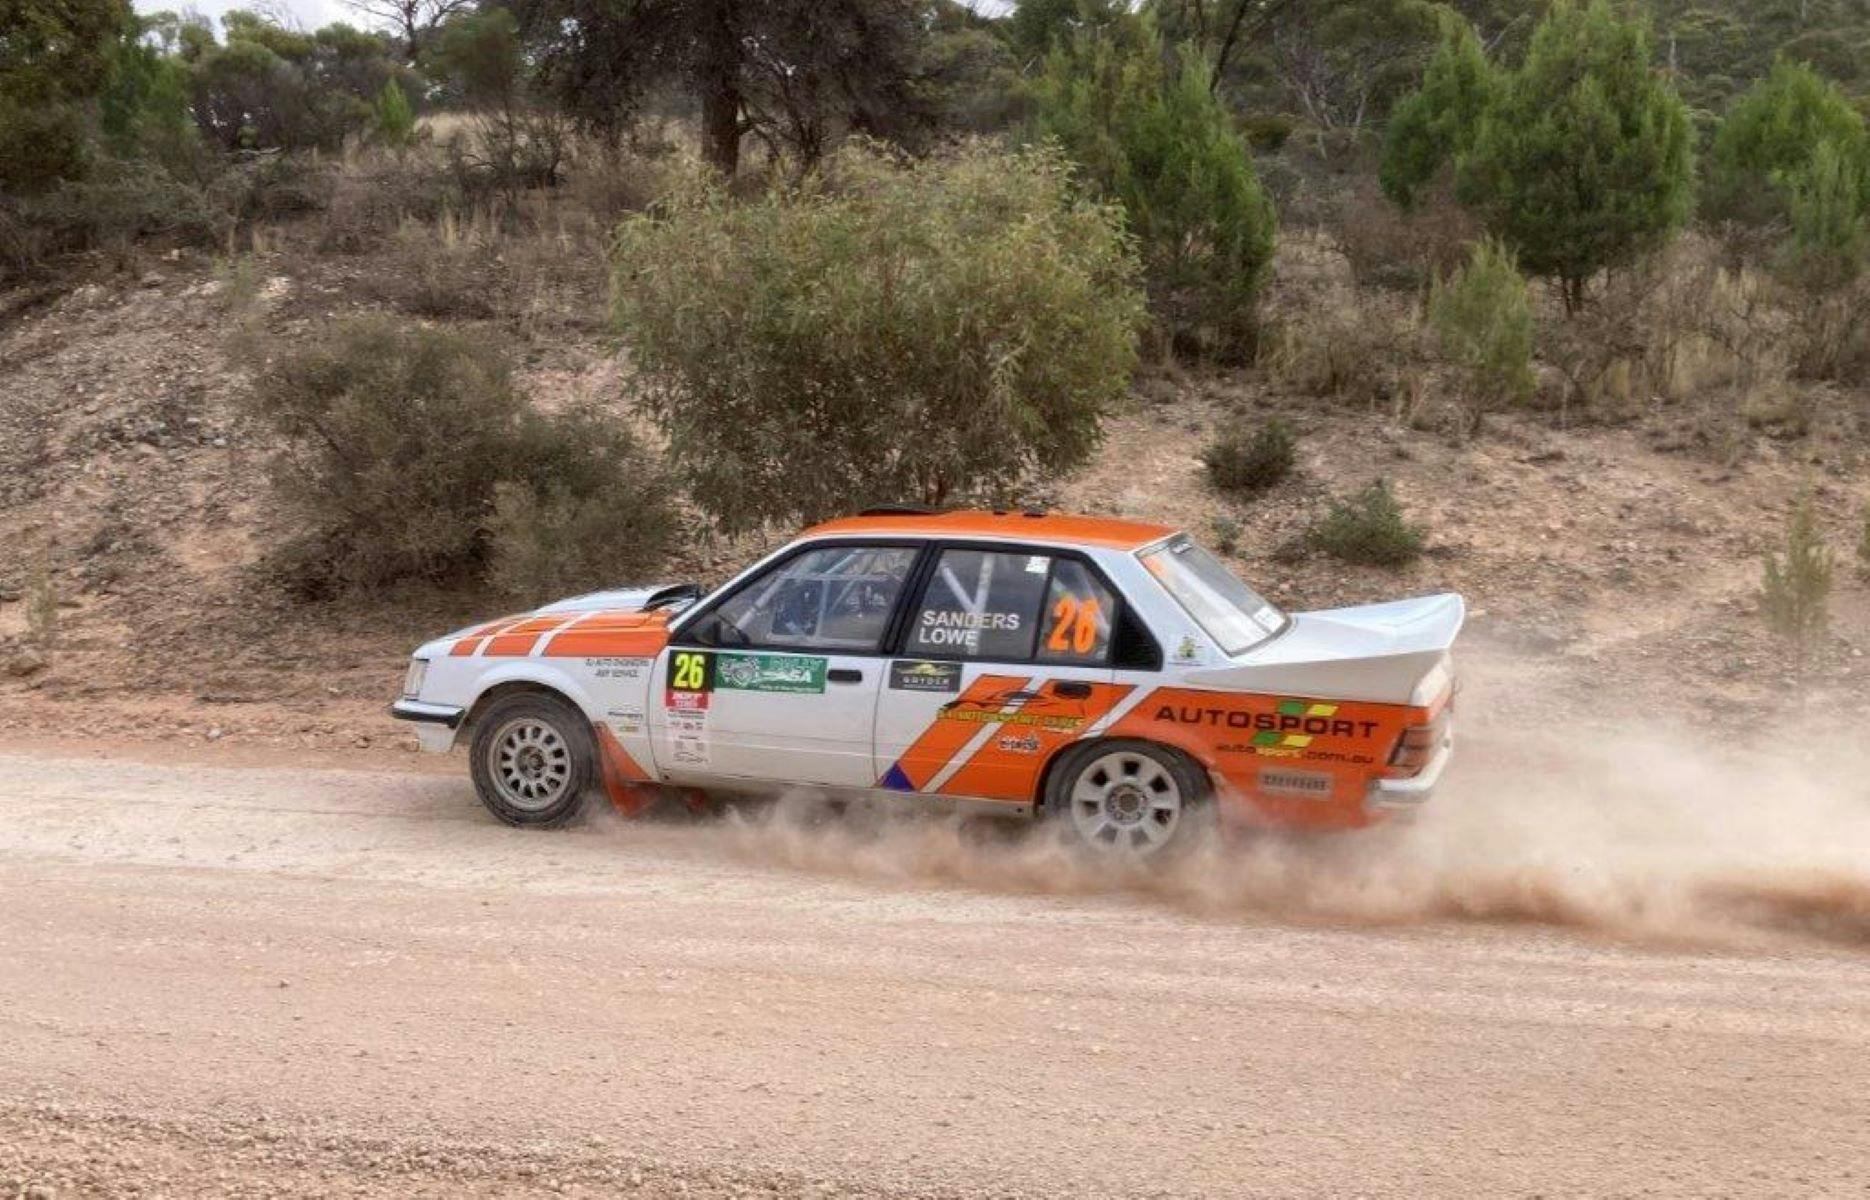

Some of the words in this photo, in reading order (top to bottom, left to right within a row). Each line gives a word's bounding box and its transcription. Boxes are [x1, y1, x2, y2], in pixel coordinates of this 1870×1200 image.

[922, 610, 1021, 630] SANDERS
[1047, 594, 1099, 654] 26
[918, 629, 979, 648] LOWE
[672, 652, 706, 689] 26
[1153, 705, 1379, 739] AUTOSPORT
